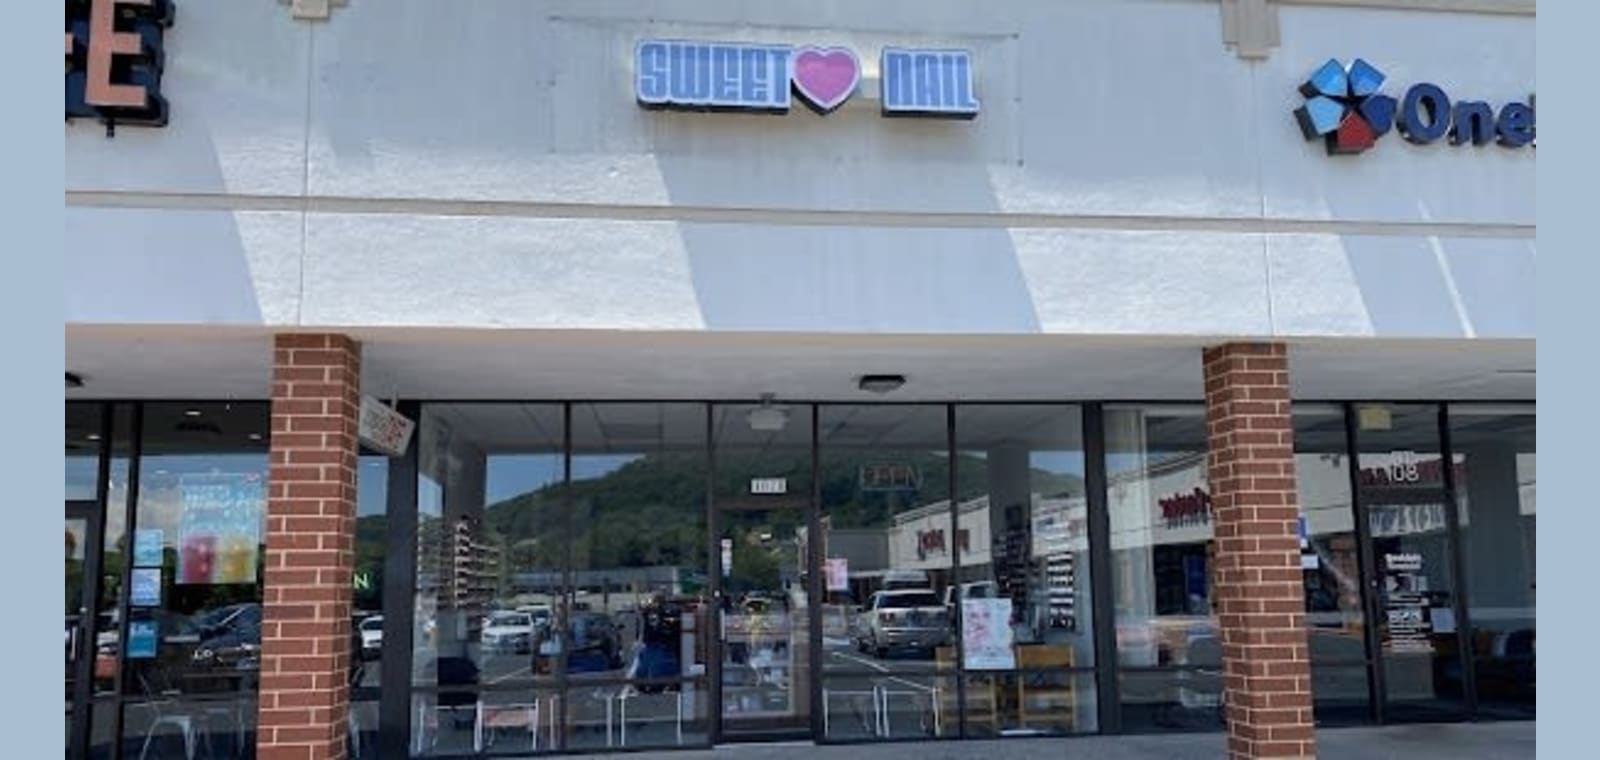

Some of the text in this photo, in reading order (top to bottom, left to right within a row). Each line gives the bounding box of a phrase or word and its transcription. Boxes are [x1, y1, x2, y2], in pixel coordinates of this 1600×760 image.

[65, 0, 147, 107] E
[636, 40, 979, 115] SWEET NAIL
[1400, 82, 1536, 148] One
